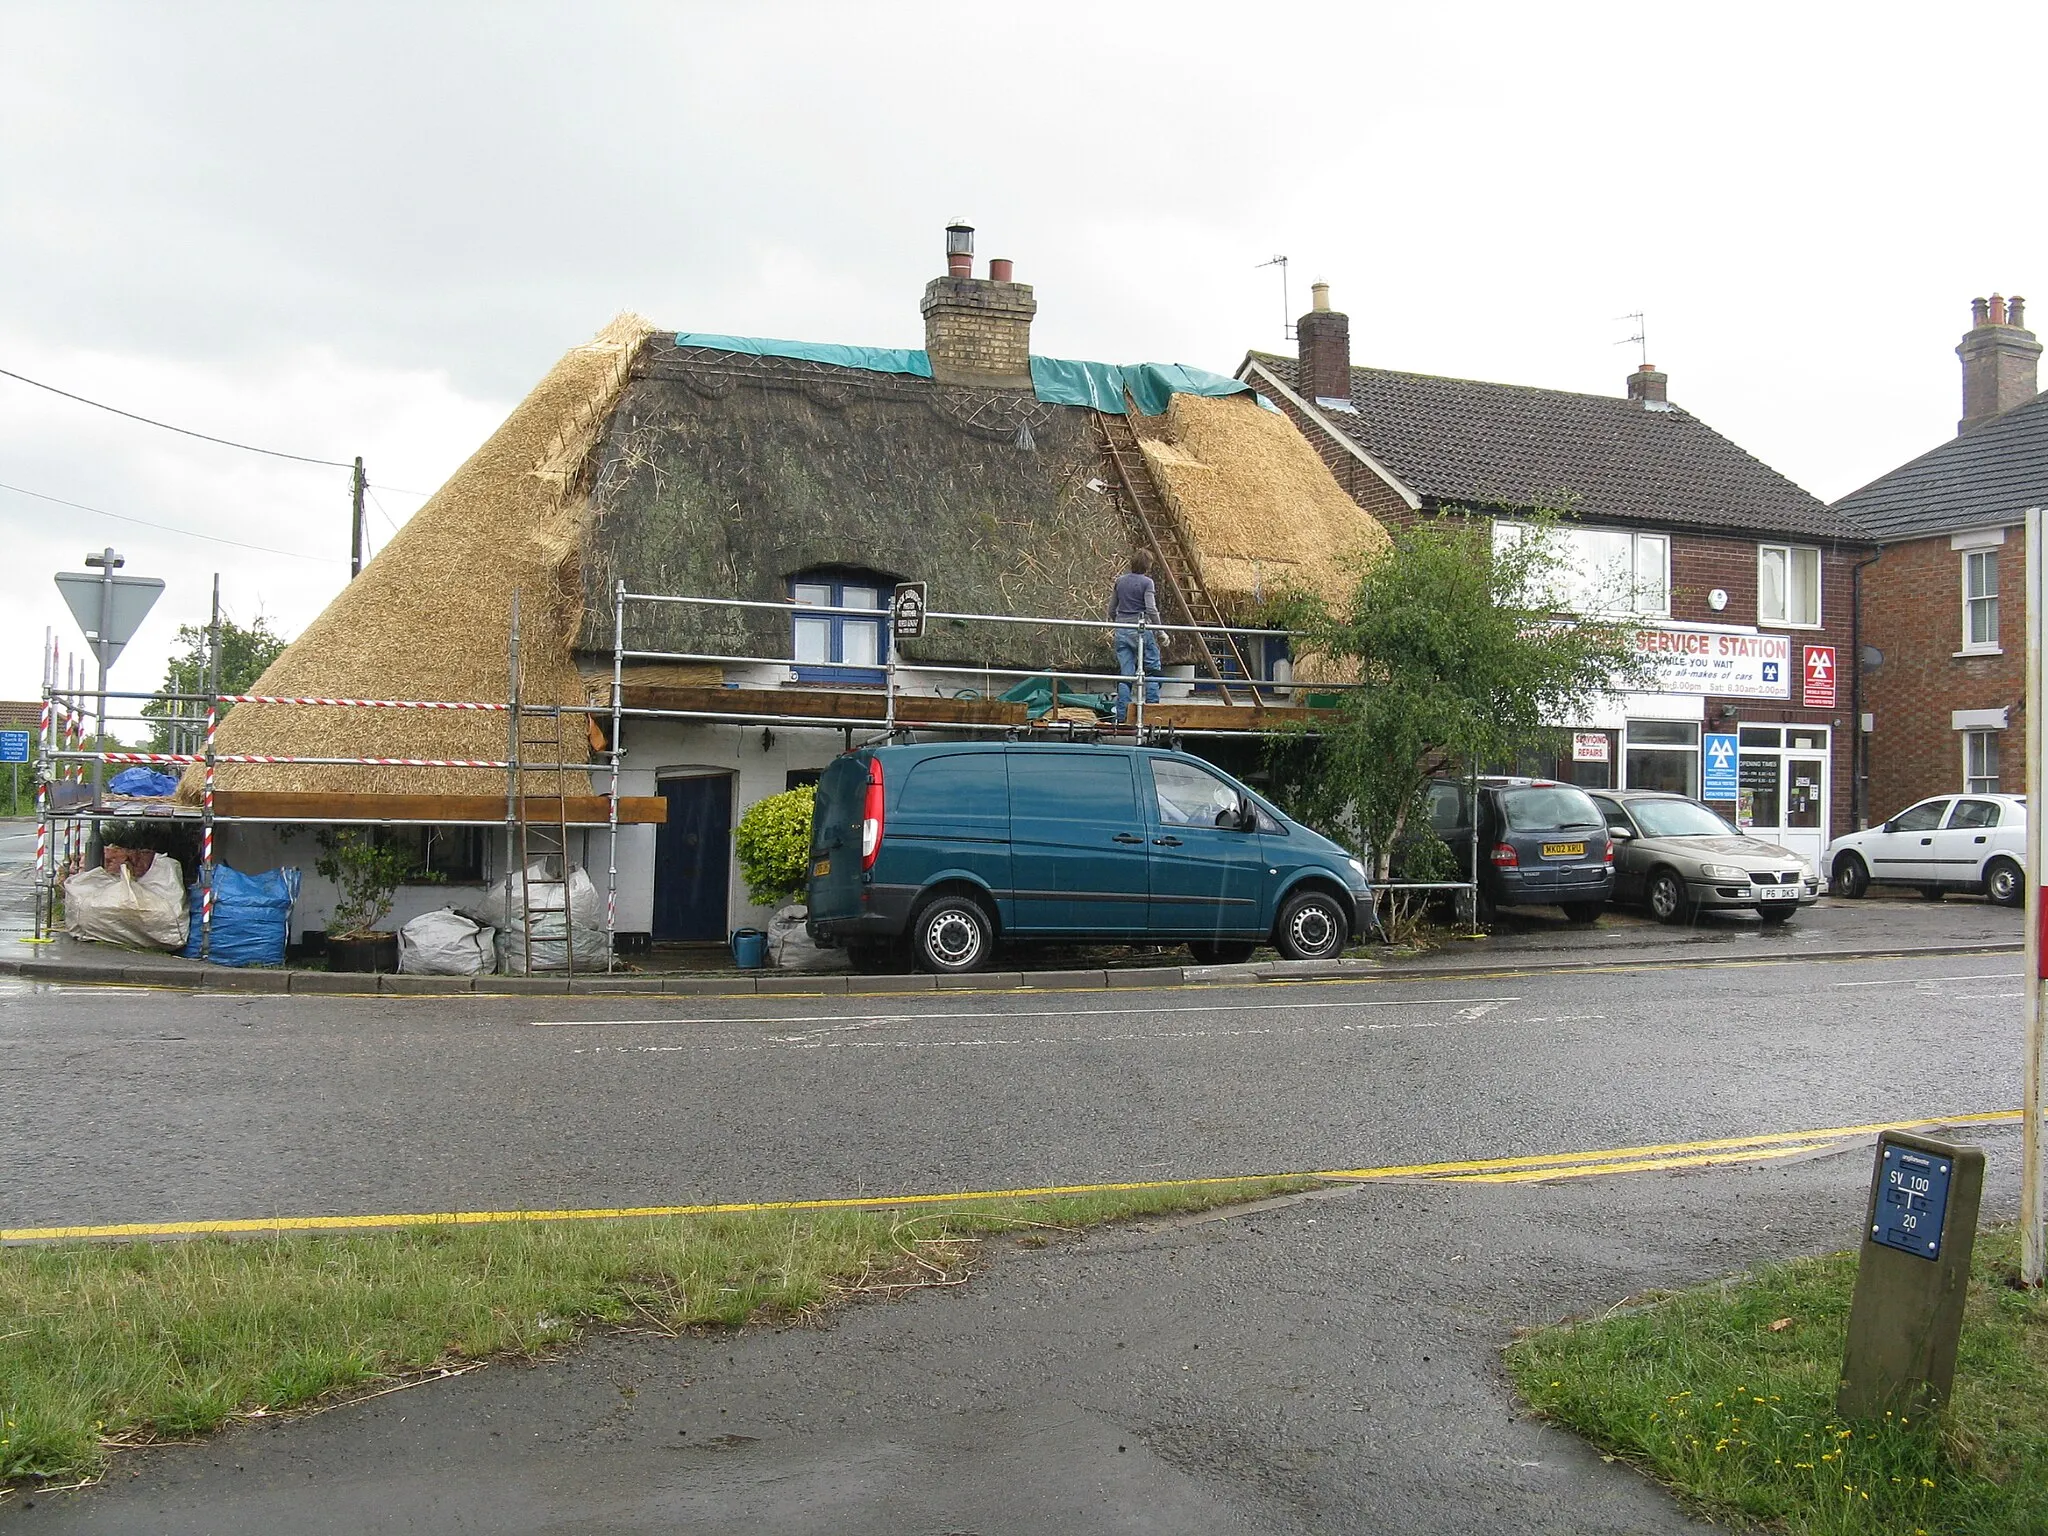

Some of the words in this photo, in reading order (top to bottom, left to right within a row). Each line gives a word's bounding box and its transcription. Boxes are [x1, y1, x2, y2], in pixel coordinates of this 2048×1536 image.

[1636, 630, 1709, 655] SERVICE
[1719, 636, 1786, 659] STATION
[1690, 658, 1708, 668] YOU
[1713, 660, 1734, 669] WAIT
[1721, 671, 1731, 680] of
[1578, 748, 1603, 757] REPAIRS
[1546, 845, 1566, 853] MK02
[1567, 844, 1581, 853] XRU
[1766, 890, 1775, 898] P6
[1782, 889, 1795, 897] DKS
[1890, 1170, 1904, 1185] SV
[1910, 1175, 1929, 1192] 100
[1902, 1214, 1917, 1229] 20
